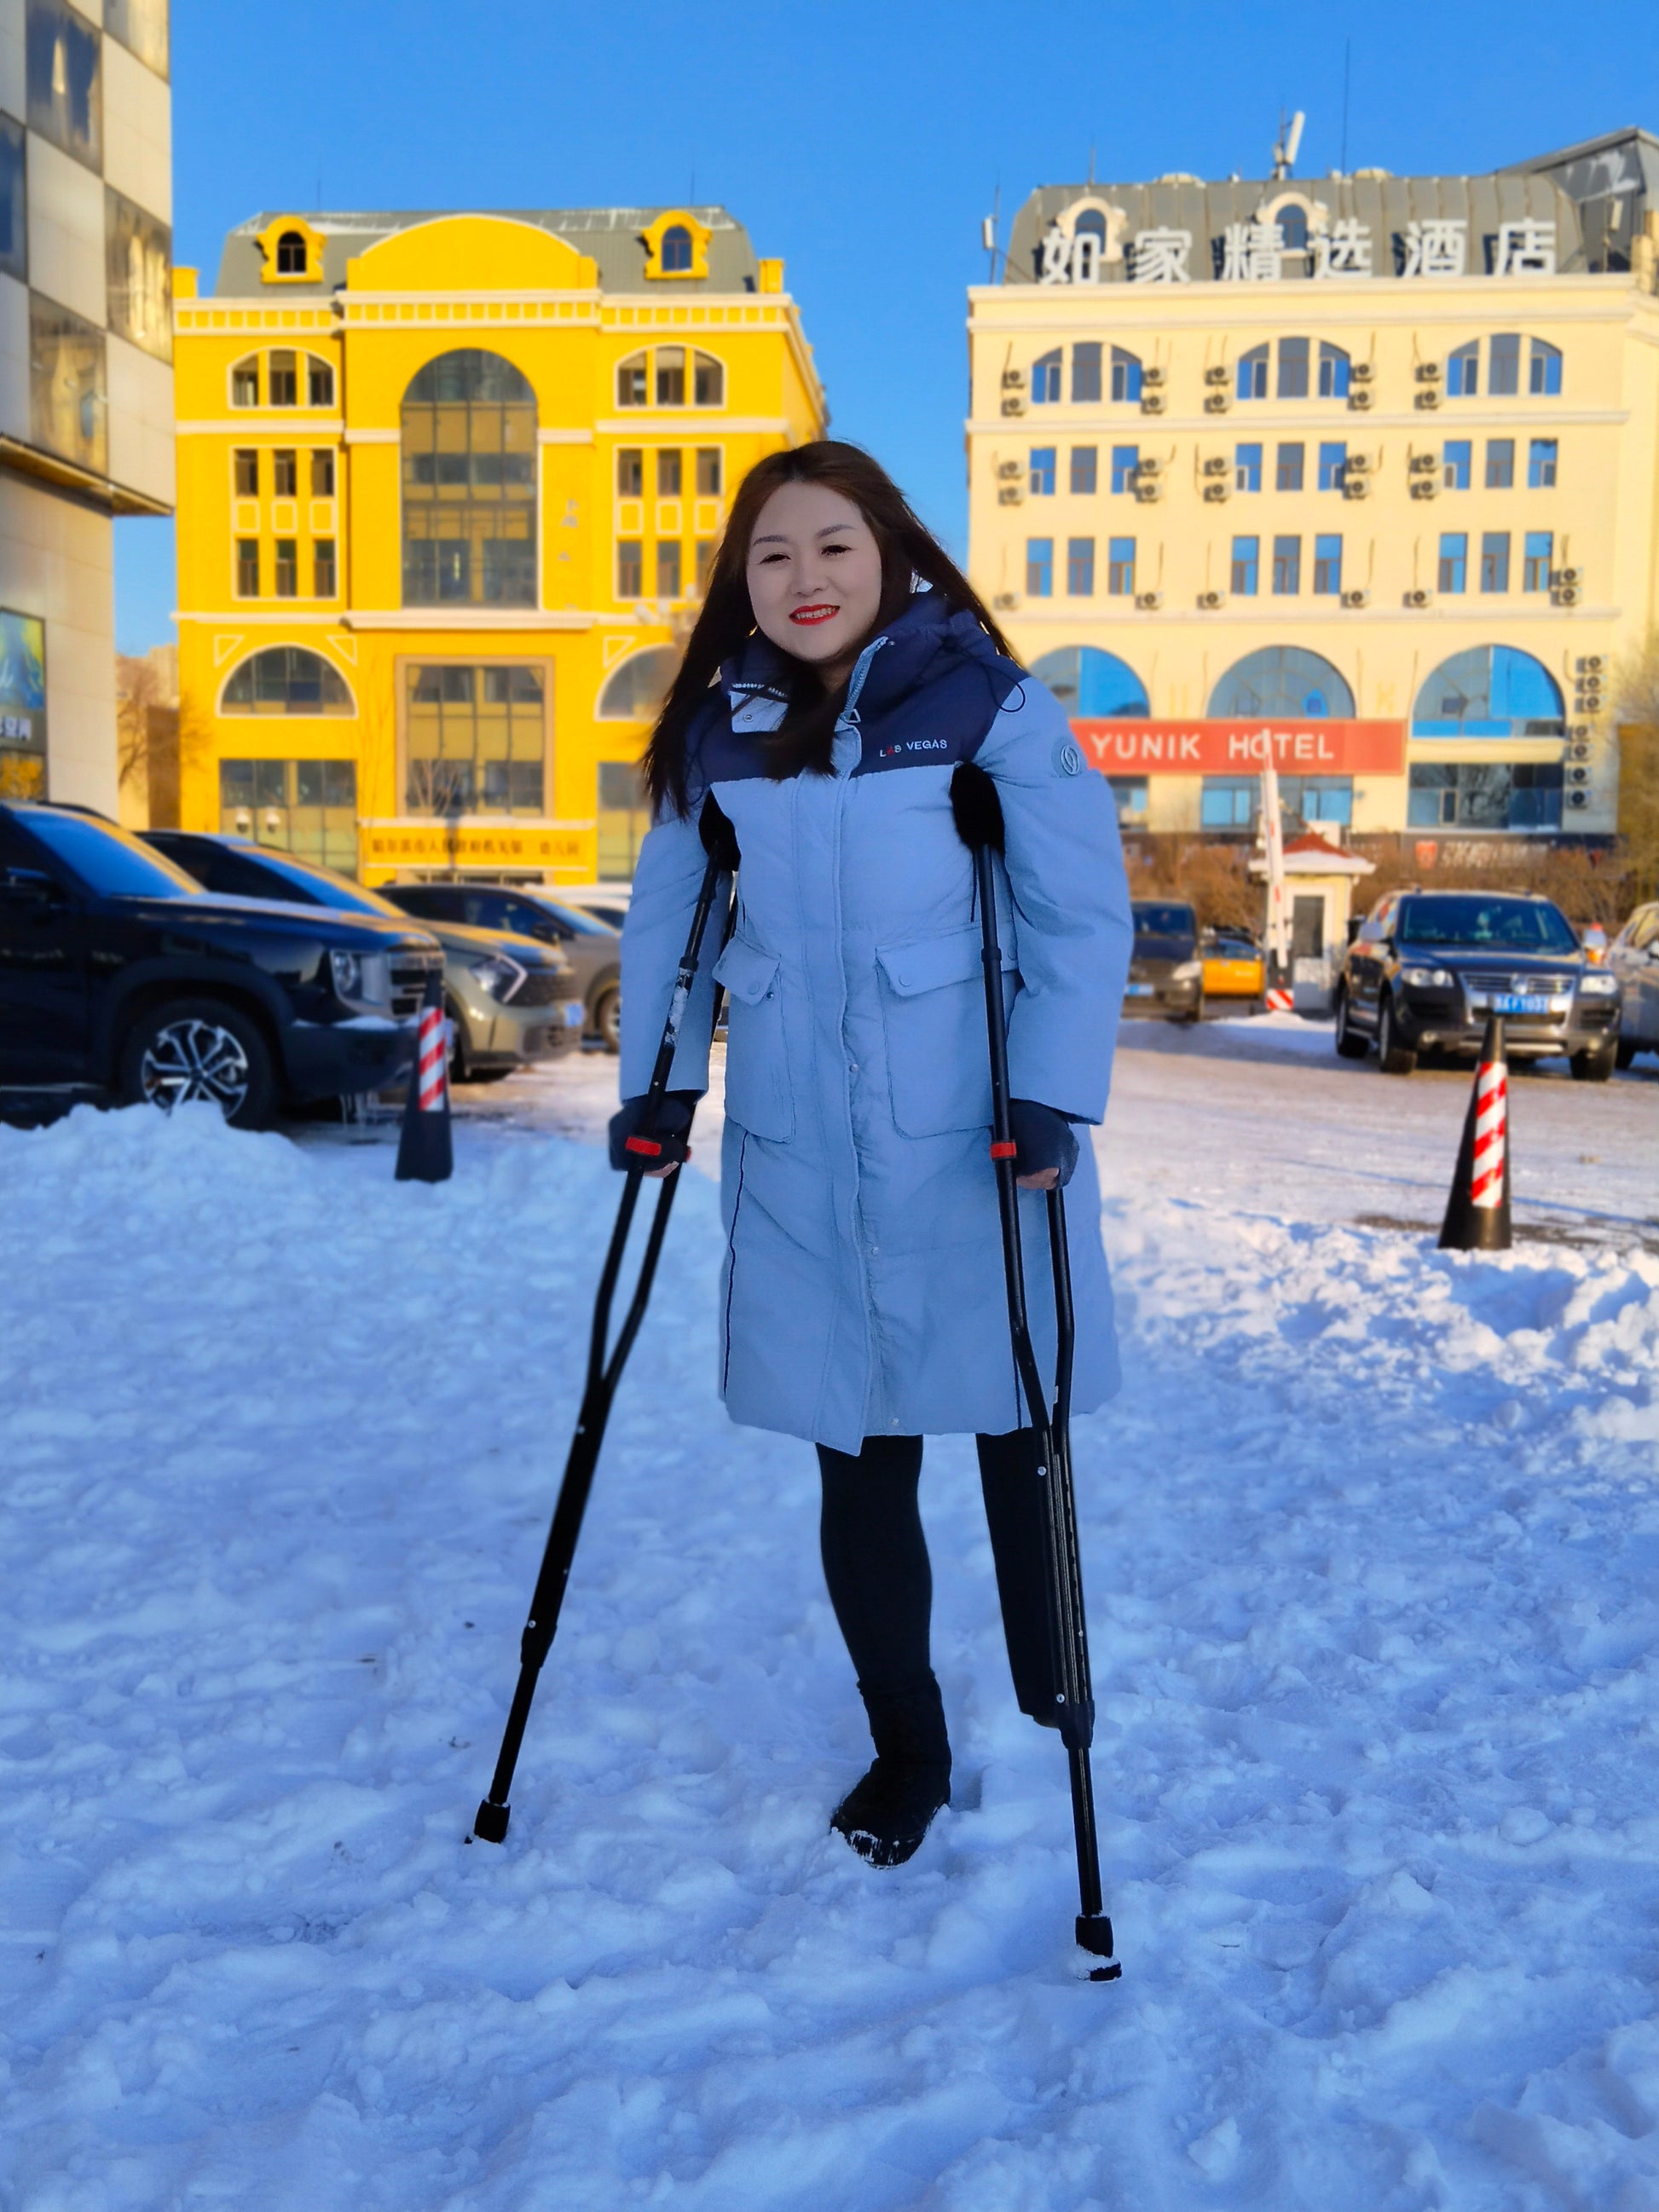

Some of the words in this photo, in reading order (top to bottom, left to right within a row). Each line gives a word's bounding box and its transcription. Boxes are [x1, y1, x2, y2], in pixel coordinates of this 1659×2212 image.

[1041, 217, 1557, 286] 如家精选酒店
[879, 744, 902, 758] LAS
[905, 739, 948, 751] VEGAS
[1090, 733, 1201, 760] YUNIK
